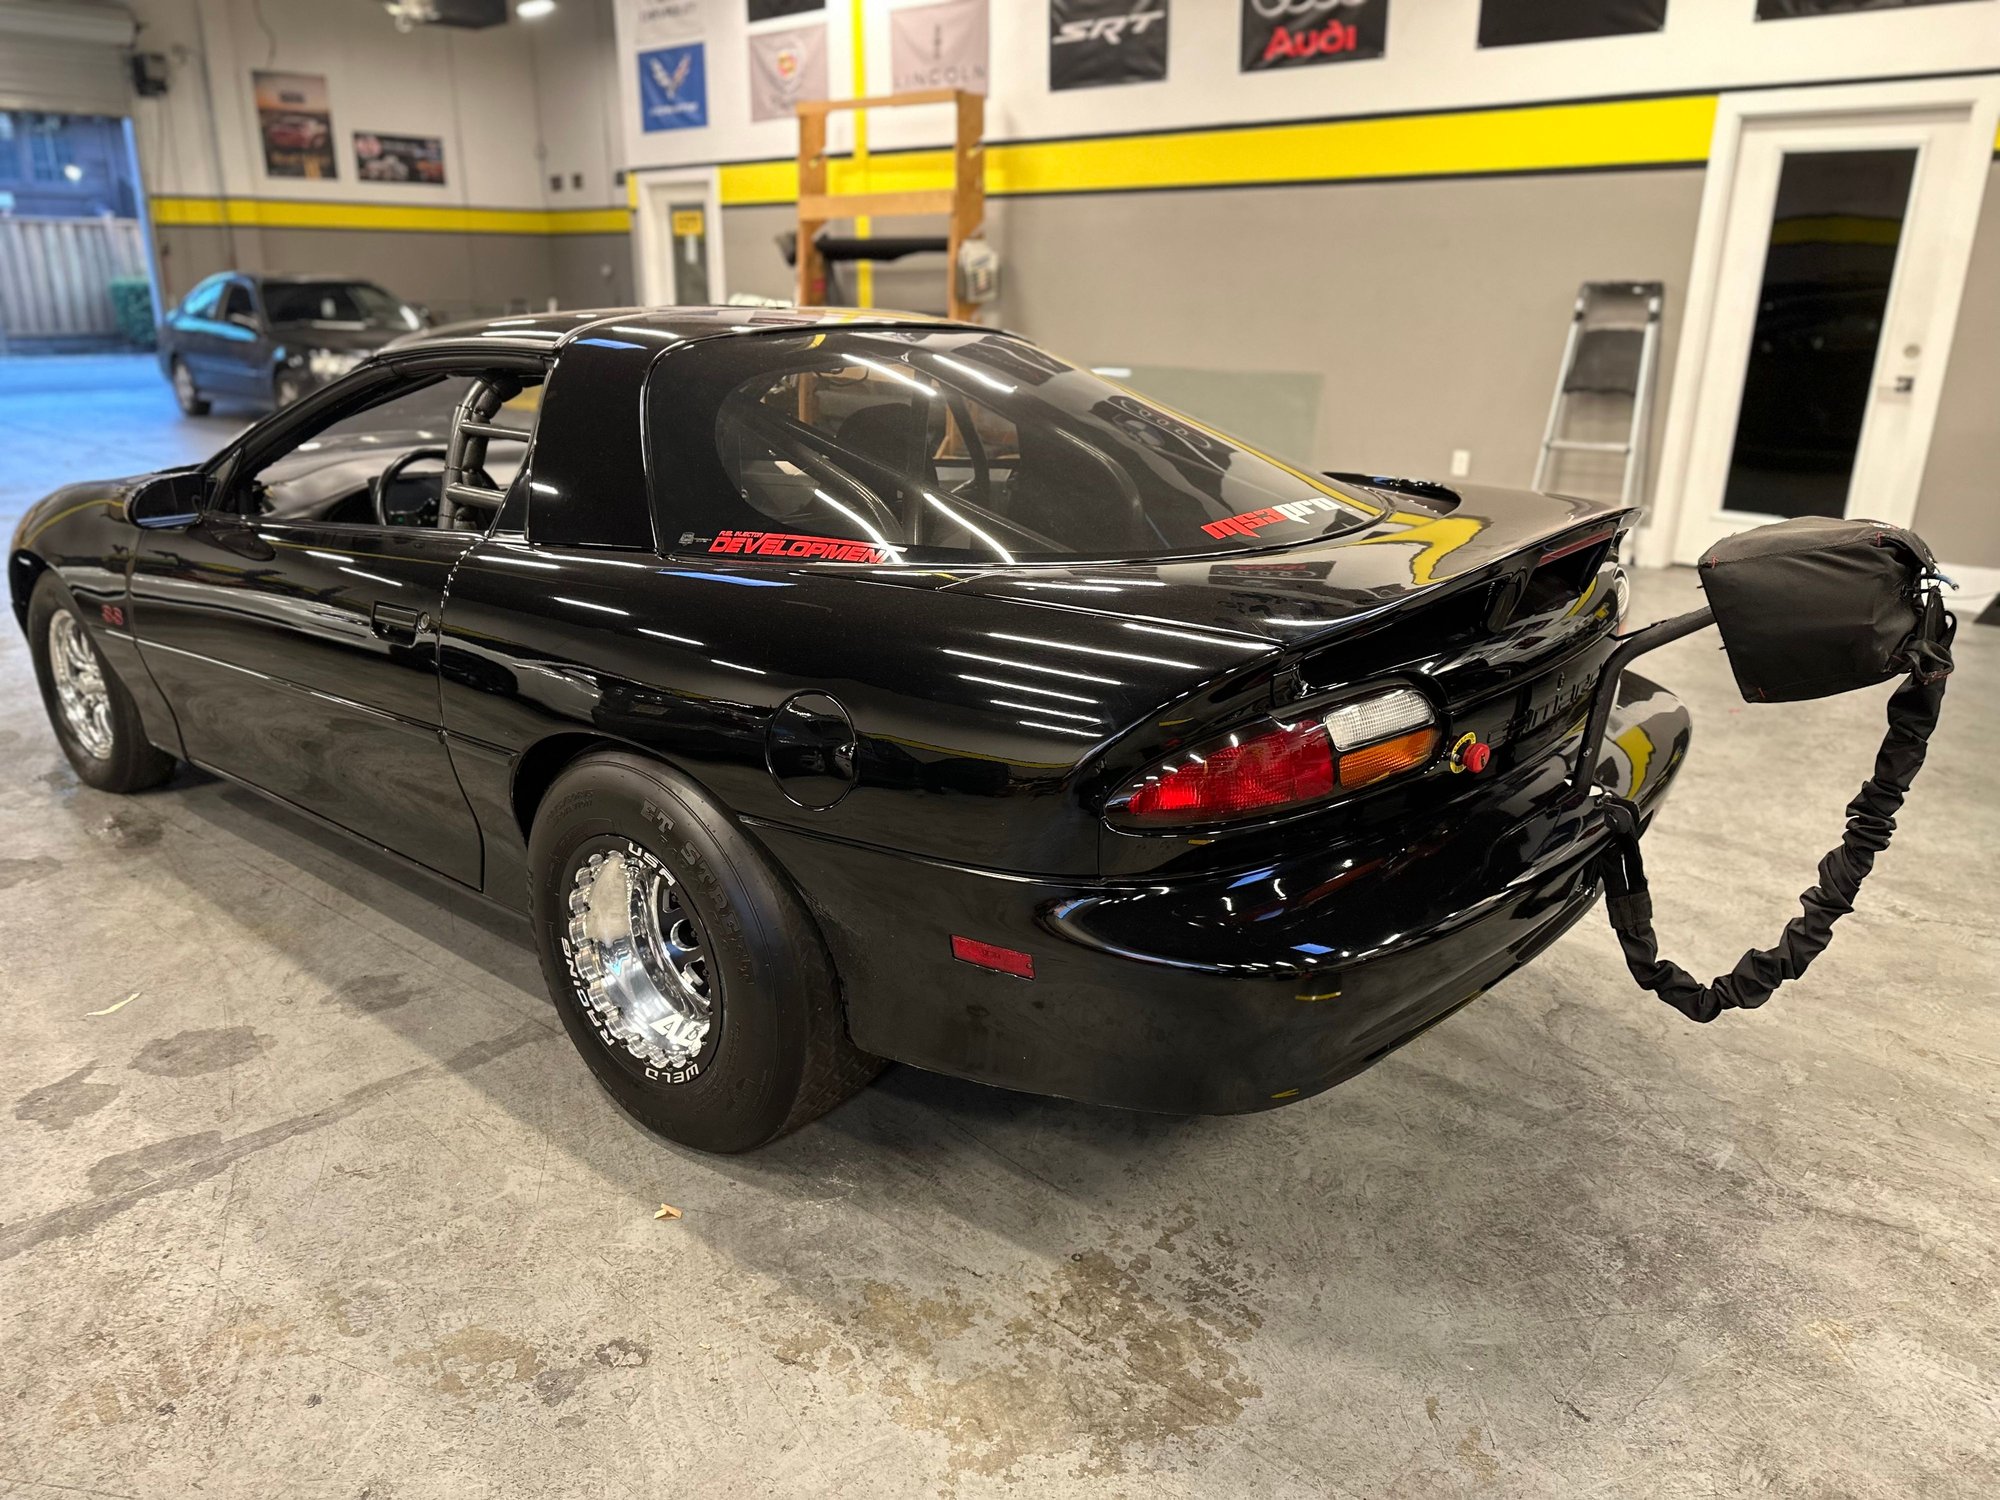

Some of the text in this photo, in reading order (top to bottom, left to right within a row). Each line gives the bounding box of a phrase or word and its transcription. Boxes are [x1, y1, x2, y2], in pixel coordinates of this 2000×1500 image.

[1052, 10, 1165, 45] SRT
[1263, 19, 1357, 61] Audi
[893, 63, 986, 90] LINCOLN
[640, 799, 677, 834] ET
[627, 841, 676, 886] USA
[561, 937, 615, 1046] RACING
[645, 1063, 700, 1083] WELD
